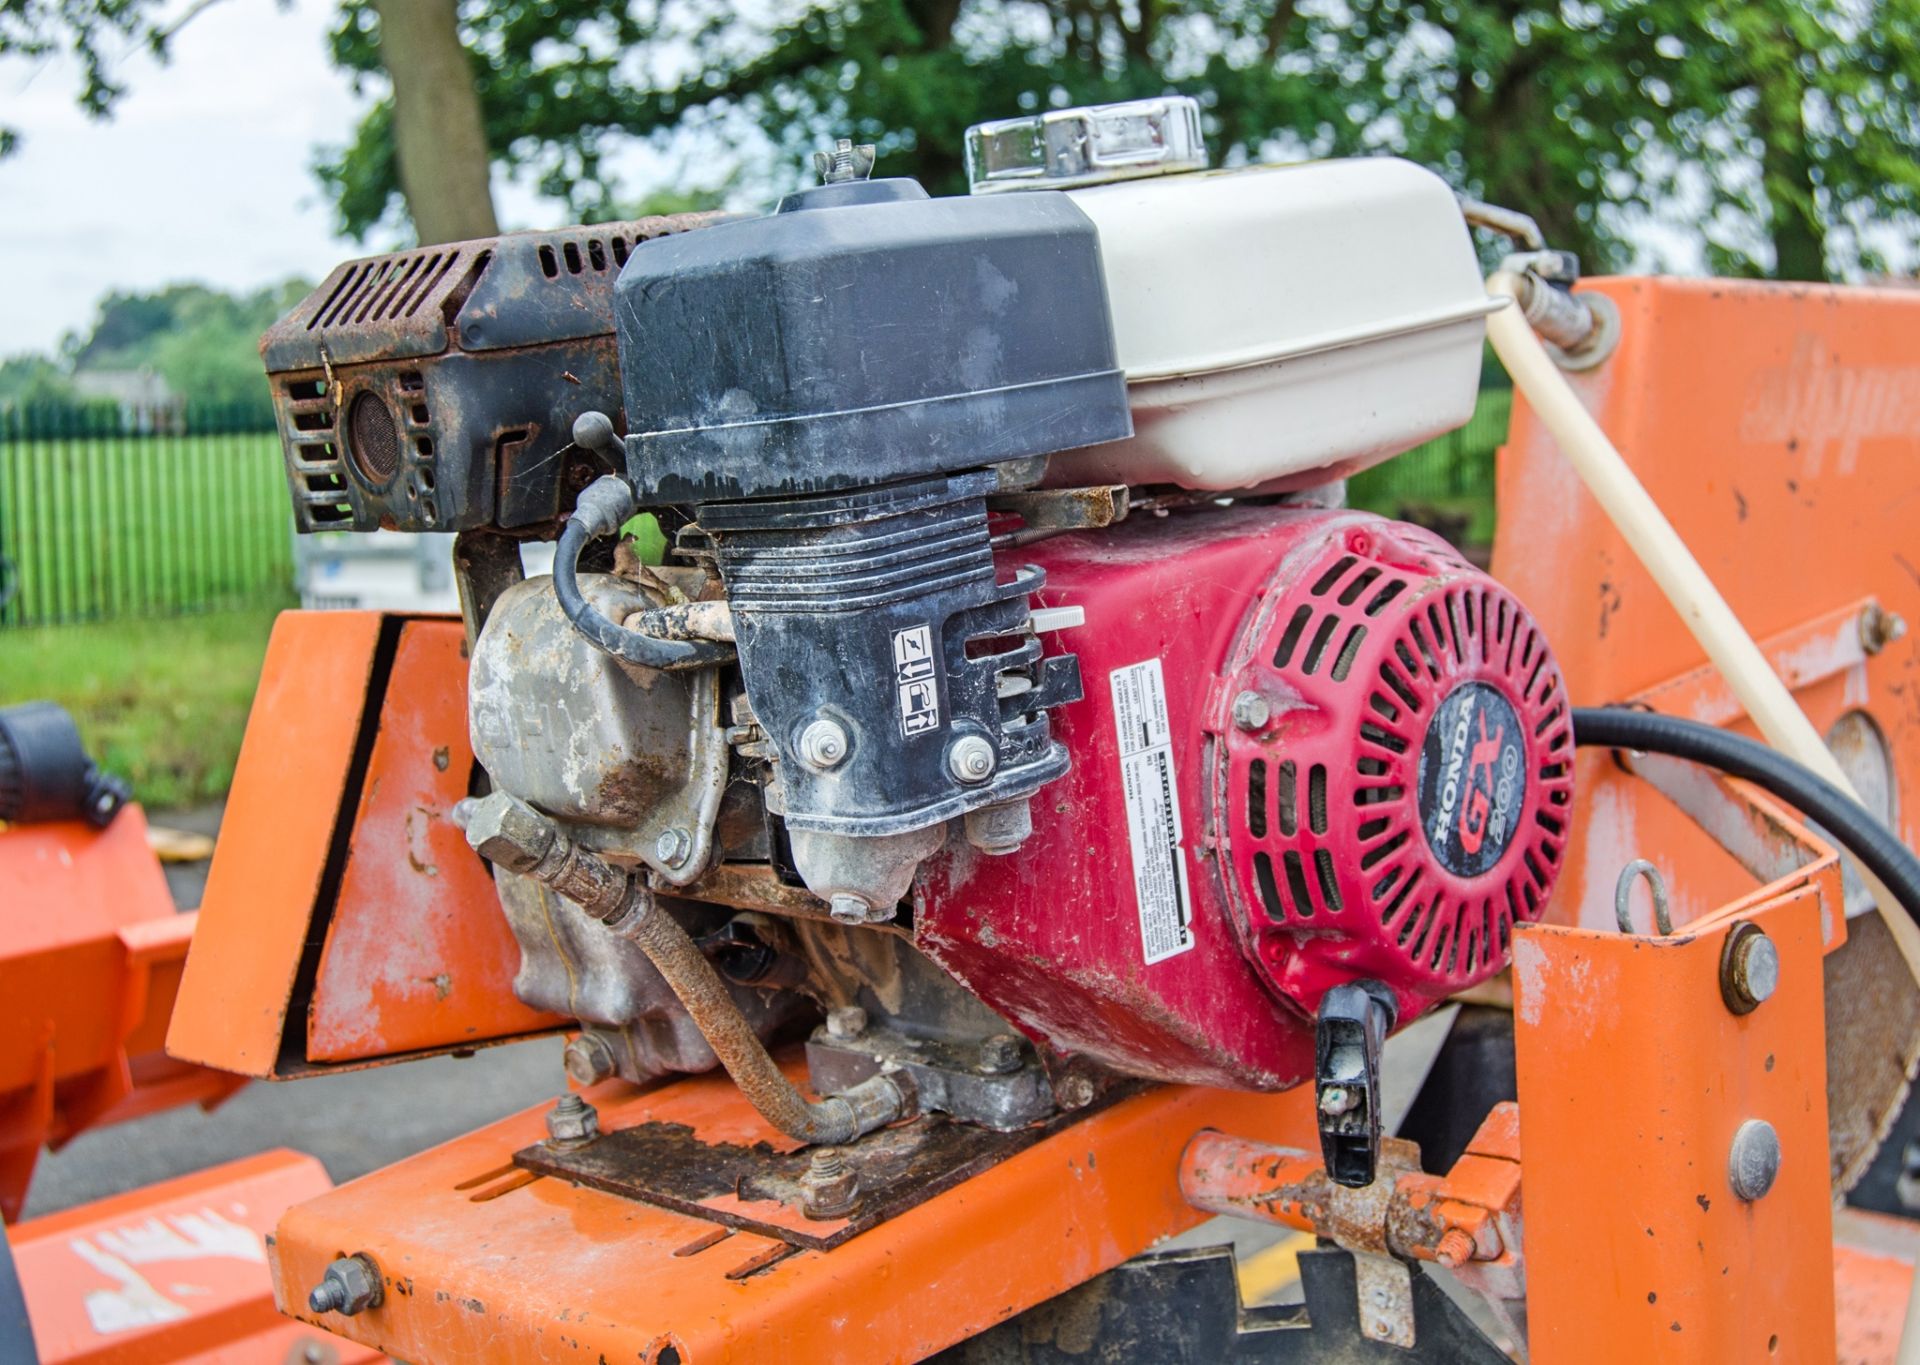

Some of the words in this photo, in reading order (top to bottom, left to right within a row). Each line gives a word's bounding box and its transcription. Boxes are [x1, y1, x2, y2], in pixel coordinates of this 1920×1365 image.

[1125, 761, 1133, 800] HONDA
[1435, 694, 1476, 843] HONDA
[1459, 707, 1504, 855] GX
[1489, 745, 1518, 845] 200
